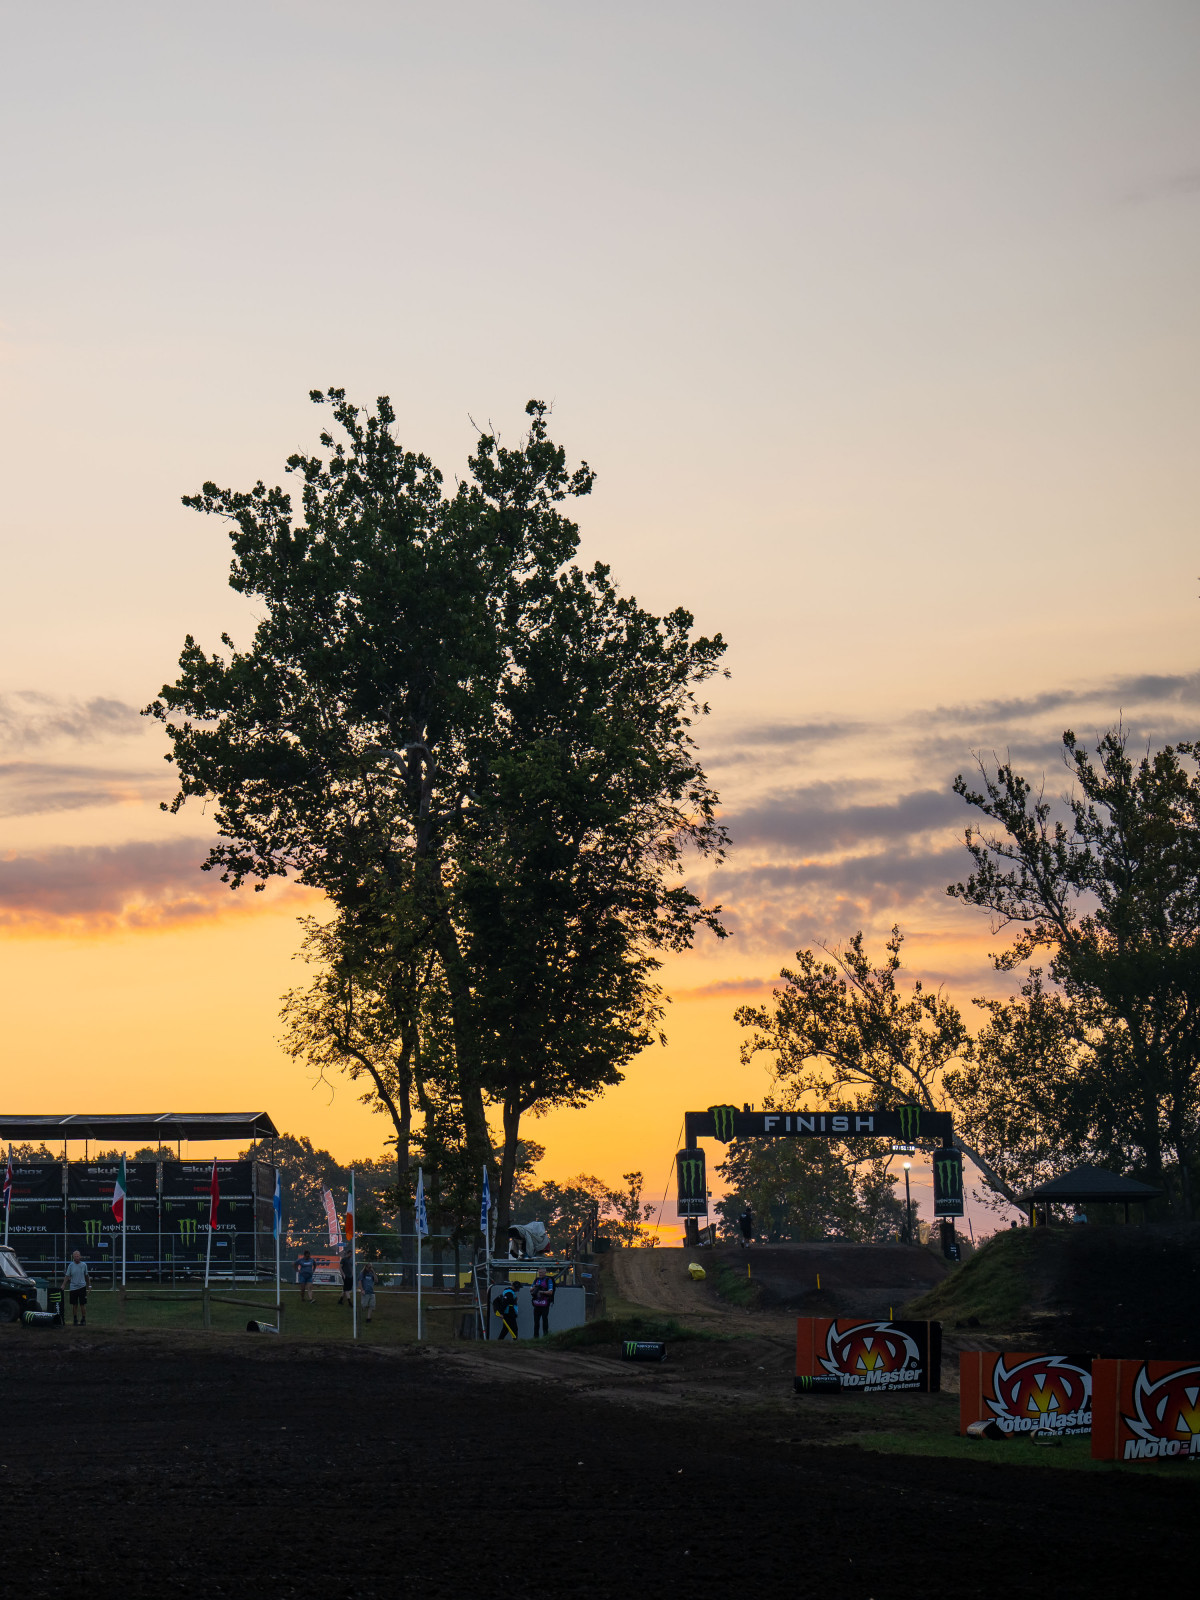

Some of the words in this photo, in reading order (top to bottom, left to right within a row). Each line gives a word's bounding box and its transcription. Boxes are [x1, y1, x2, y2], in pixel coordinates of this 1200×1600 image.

[764, 1115, 874, 1132] FINISH
[864, 1383, 887, 1393] Brake
[888, 1382, 921, 1390] Systems
